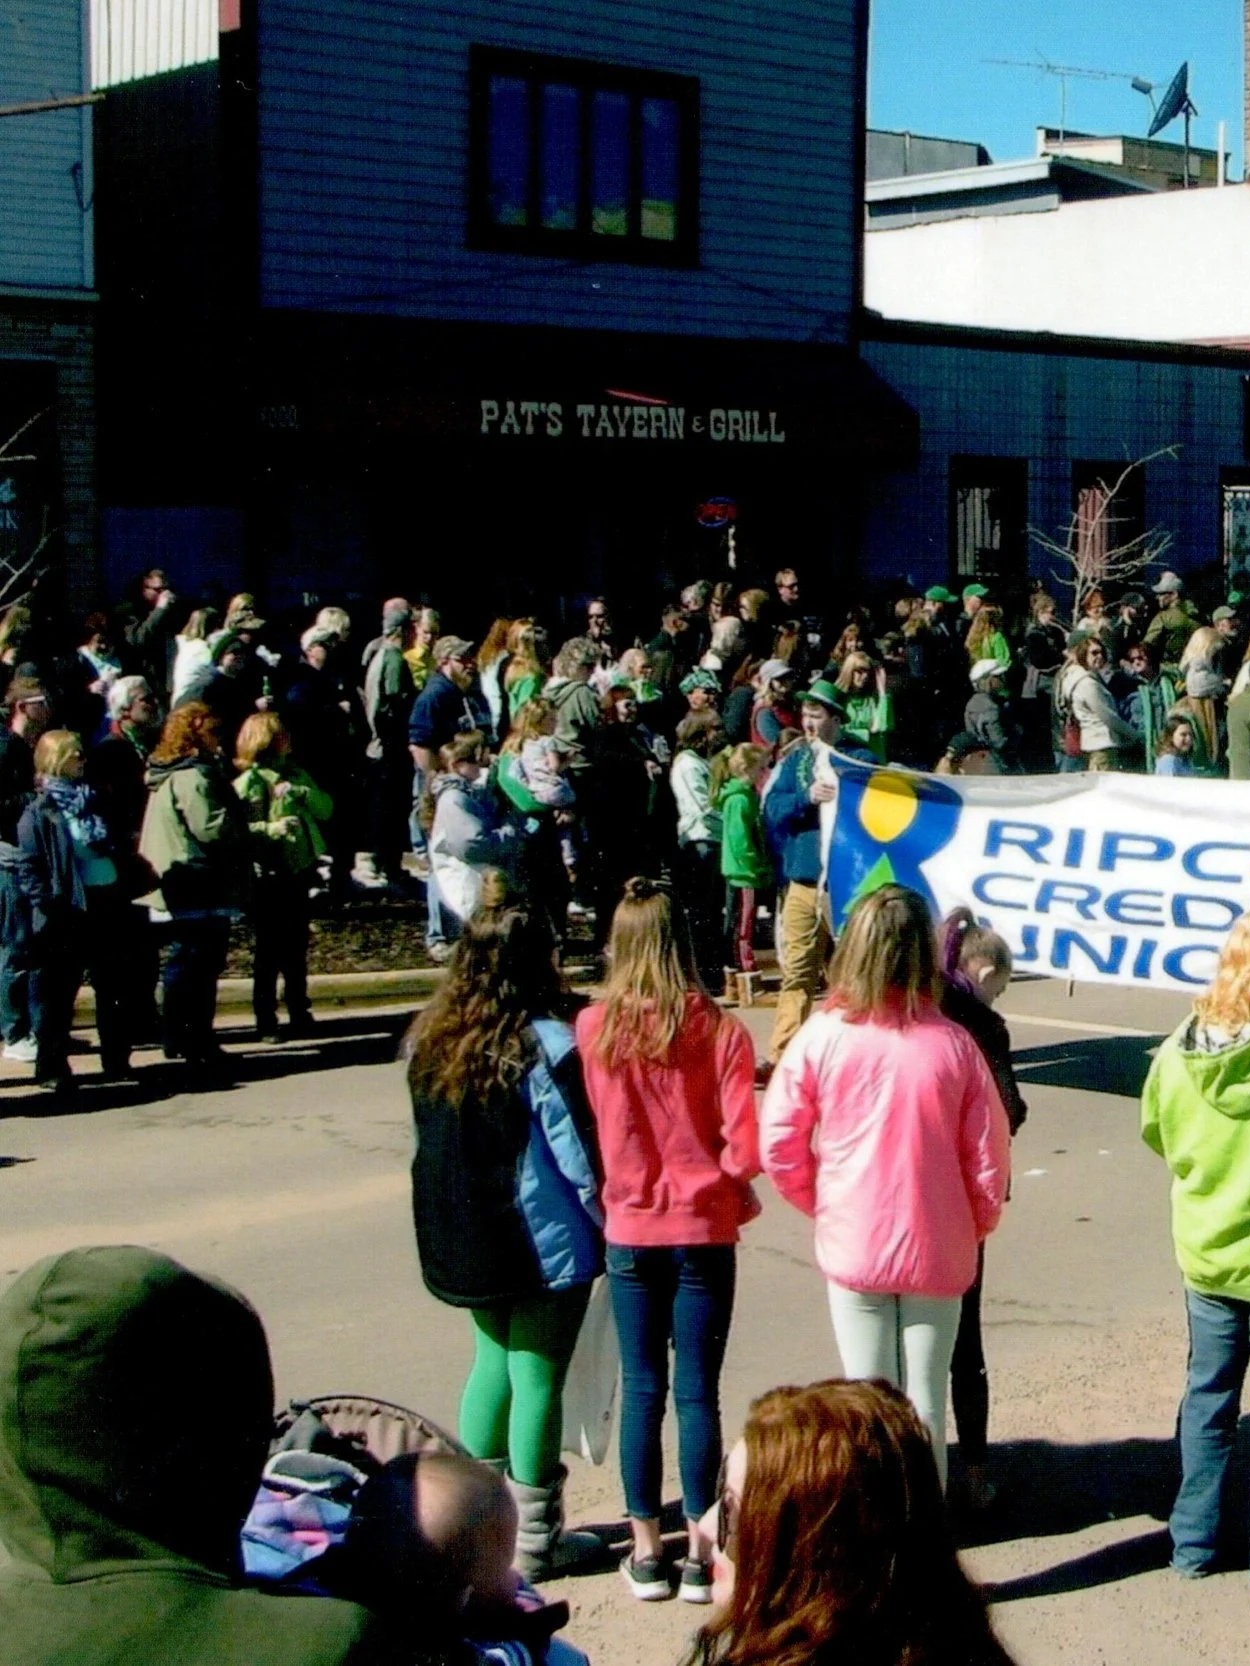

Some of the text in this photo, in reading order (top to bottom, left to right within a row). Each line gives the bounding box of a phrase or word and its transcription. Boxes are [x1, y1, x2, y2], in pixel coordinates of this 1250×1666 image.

[480, 400, 563, 436] PAT'S
[576, 404, 686, 440] TAVERN
[709, 408, 786, 443] GRILL
